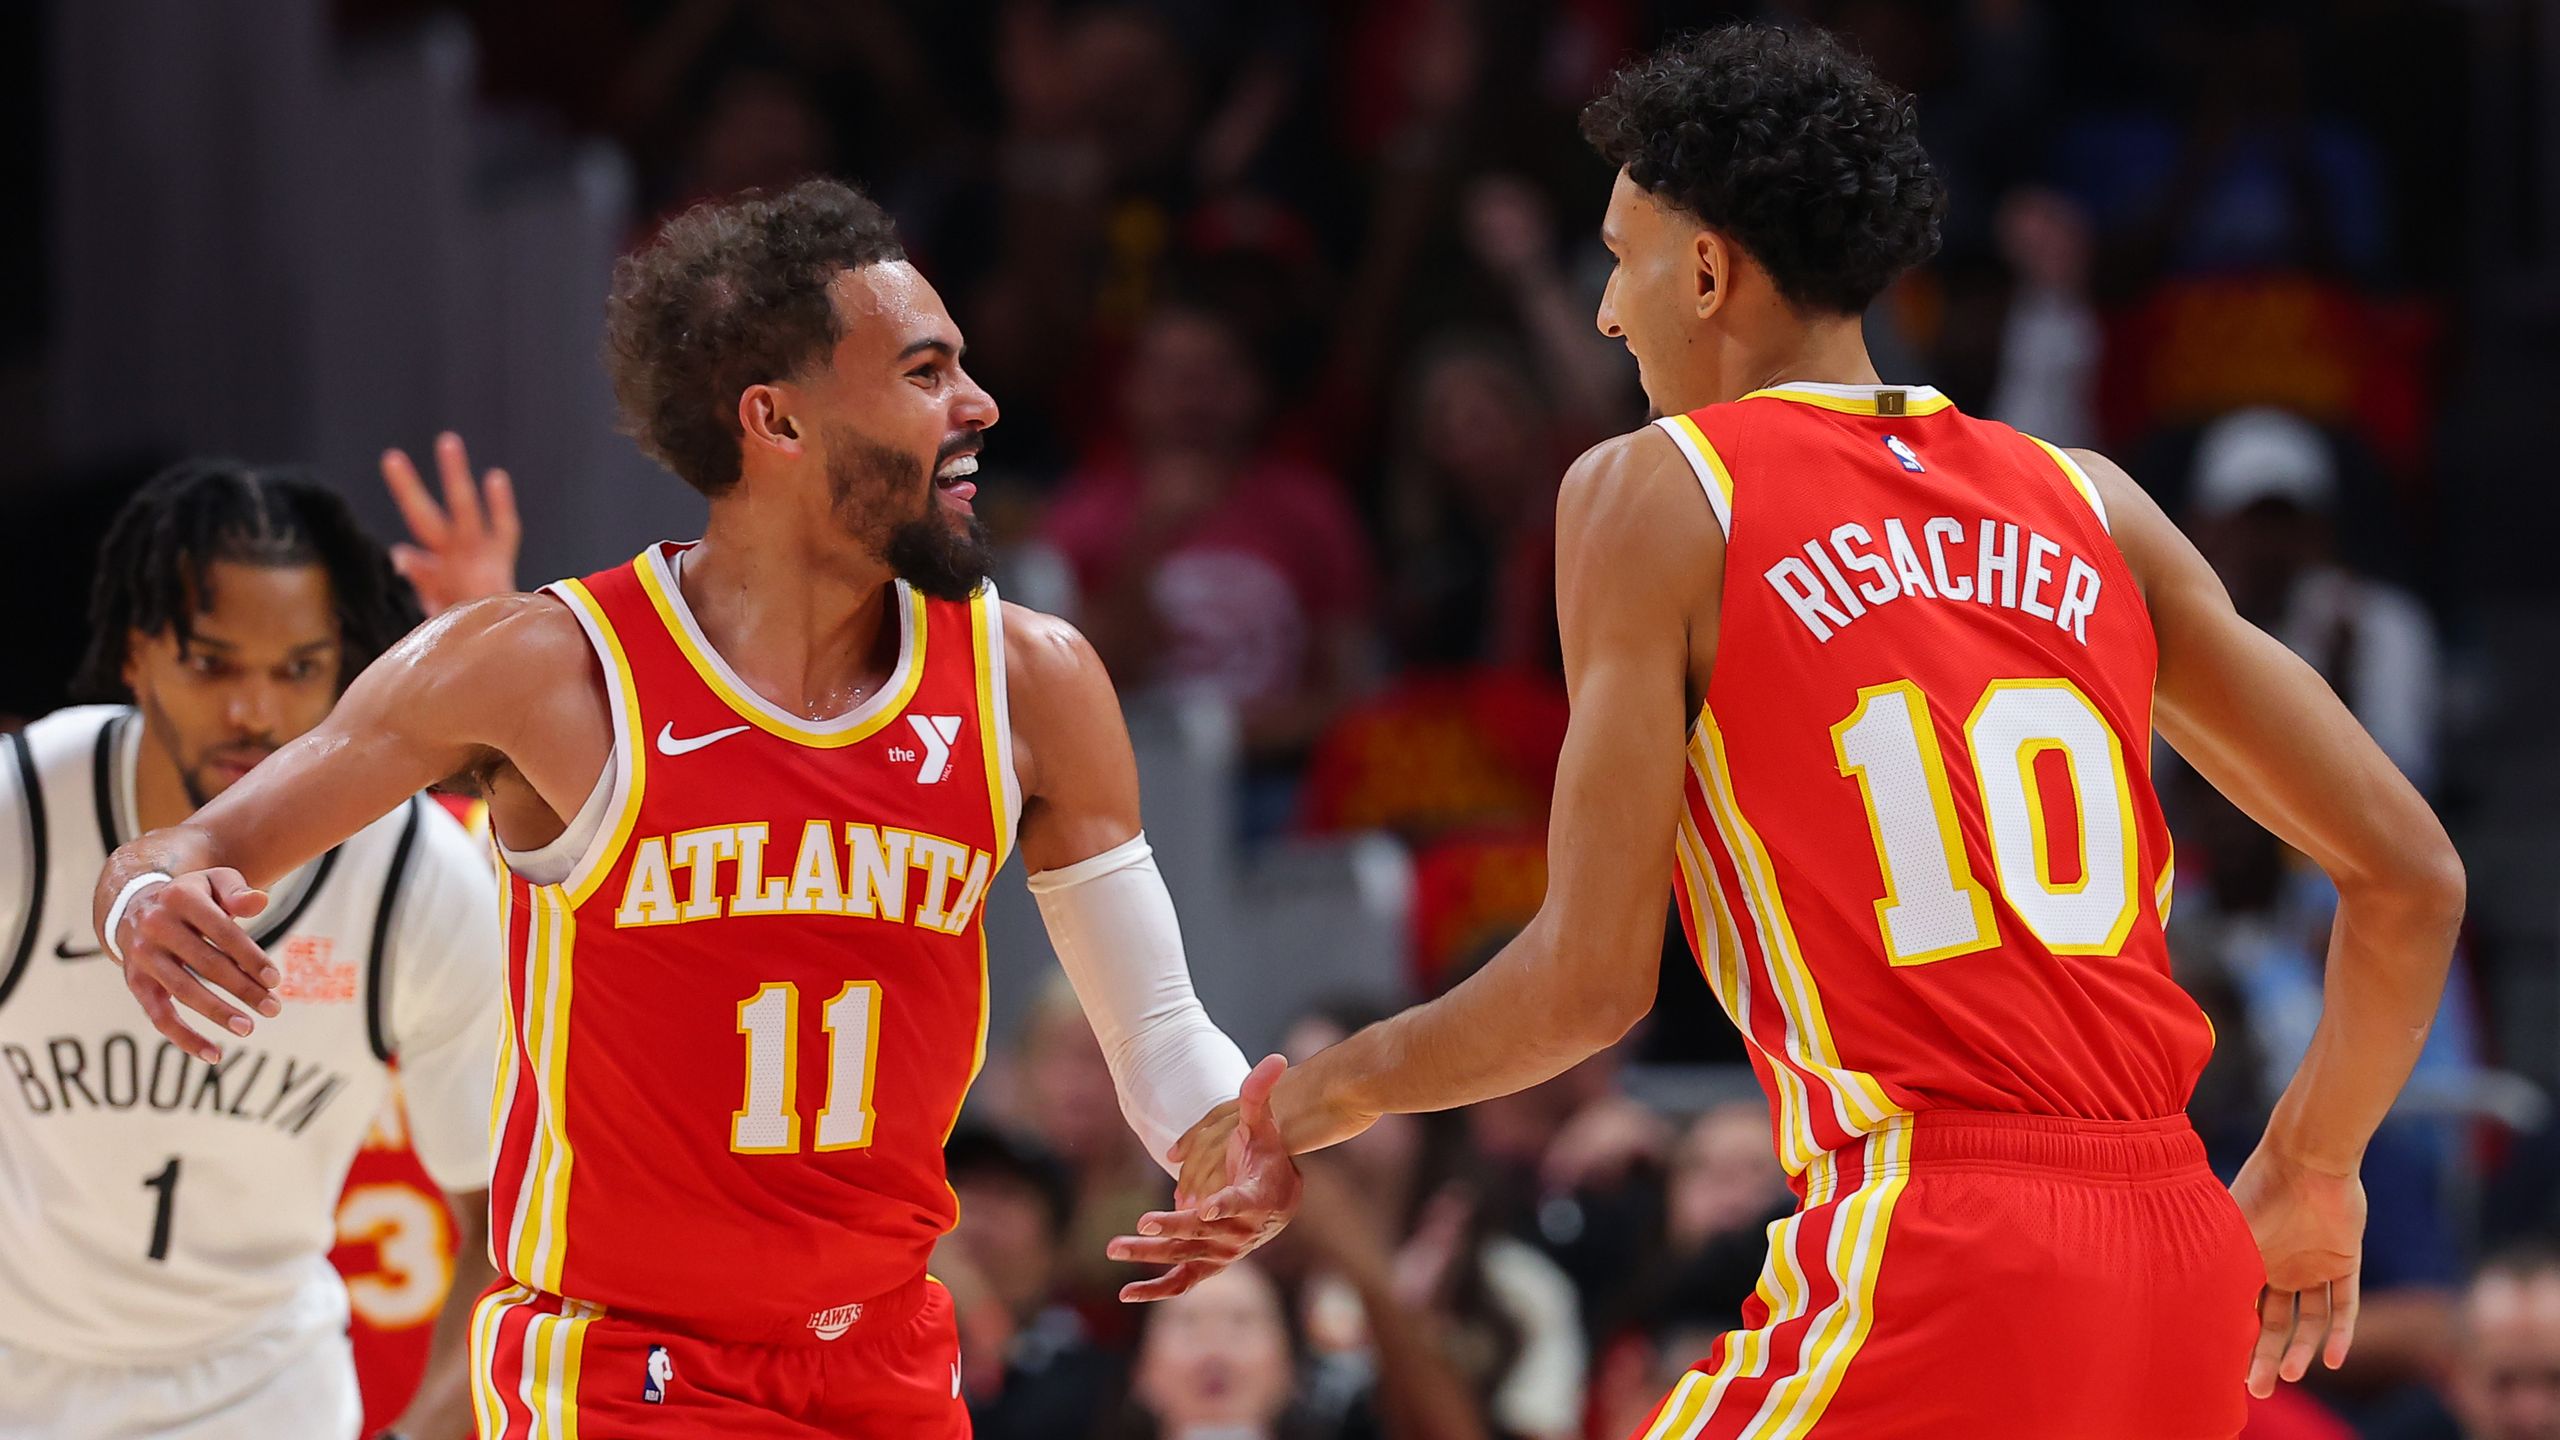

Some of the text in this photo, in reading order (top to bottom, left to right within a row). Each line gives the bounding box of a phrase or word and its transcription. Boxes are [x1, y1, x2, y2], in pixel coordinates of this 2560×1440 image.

[1887, 396, 1894, 411] 1
[1763, 516, 2101, 646] RISACHER
[888, 714, 963, 784] the Y
[940, 763, 954, 782] YMCA
[1829, 677, 2139, 967] 10
[614, 819, 992, 937] ATLANTA
[3, 1033, 350, 1136] BROOKLYN
[730, 980, 883, 1154] 11
[143, 1153, 182, 1261] 1
[806, 1303, 863, 1328] HAWKS
